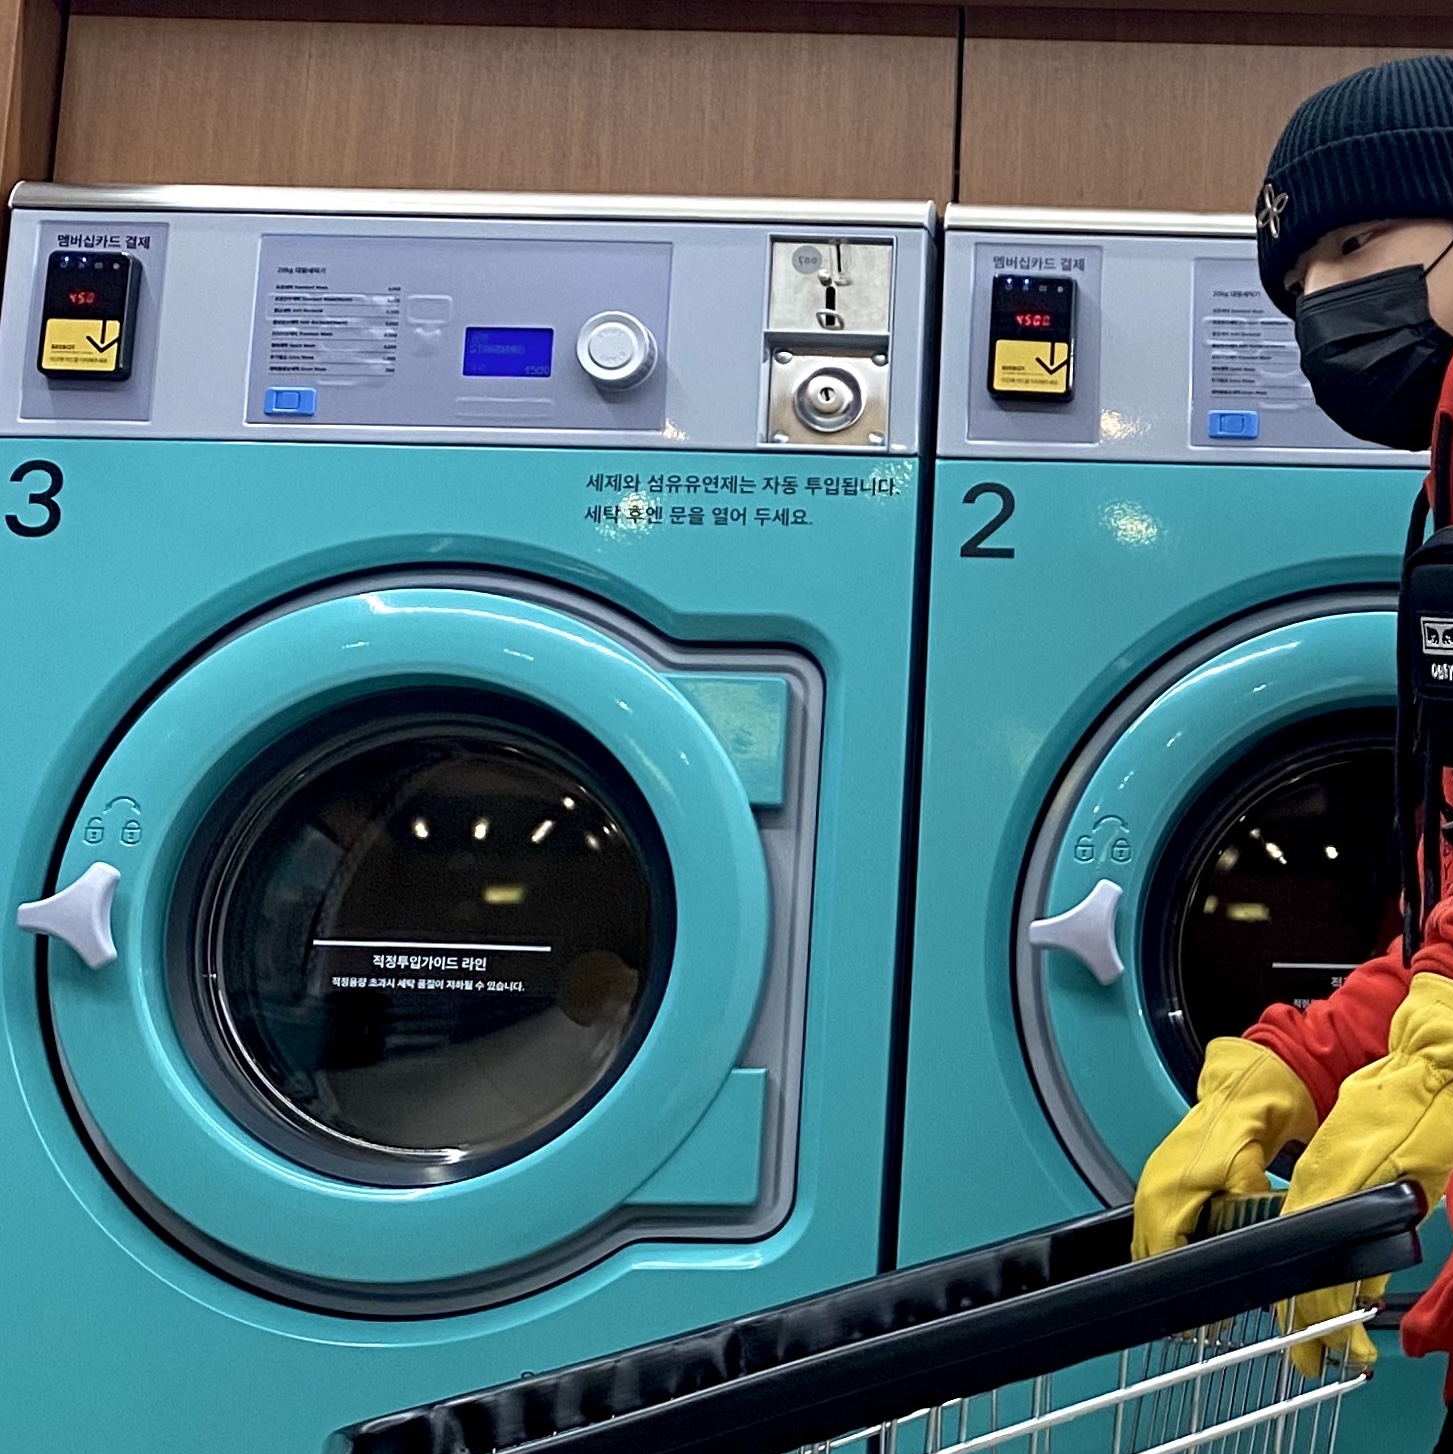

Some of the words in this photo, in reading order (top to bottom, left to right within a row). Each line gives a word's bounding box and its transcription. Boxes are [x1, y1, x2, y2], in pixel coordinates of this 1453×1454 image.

[57, 233, 121, 249] 멤버십카드
[125, 235, 151, 251] 결제
[993, 255, 1056, 271] 멤버십카드
[1060, 257, 1085, 272] 결제
[586, 474, 640, 493] 세제와
[647, 475, 756, 495] 섬유유연제는
[761, 476, 797, 495] 자동
[804, 476, 901, 497] 투입됩니다.
[5, 459, 63, 538] 3
[585, 504, 618, 523] 세탁
[627, 505, 663, 525] 후엔
[669, 506, 705, 526] 문을
[711, 507, 747, 526] 열어
[754, 507, 814, 527] 두세요.
[960, 482, 1016, 559] 2
[1431, 663, 1453, 681] OBEY
[373, 954, 458, 969] 적정투입가이드
[462, 956, 487, 971] 라인
[475, 981, 485, 991] 수
